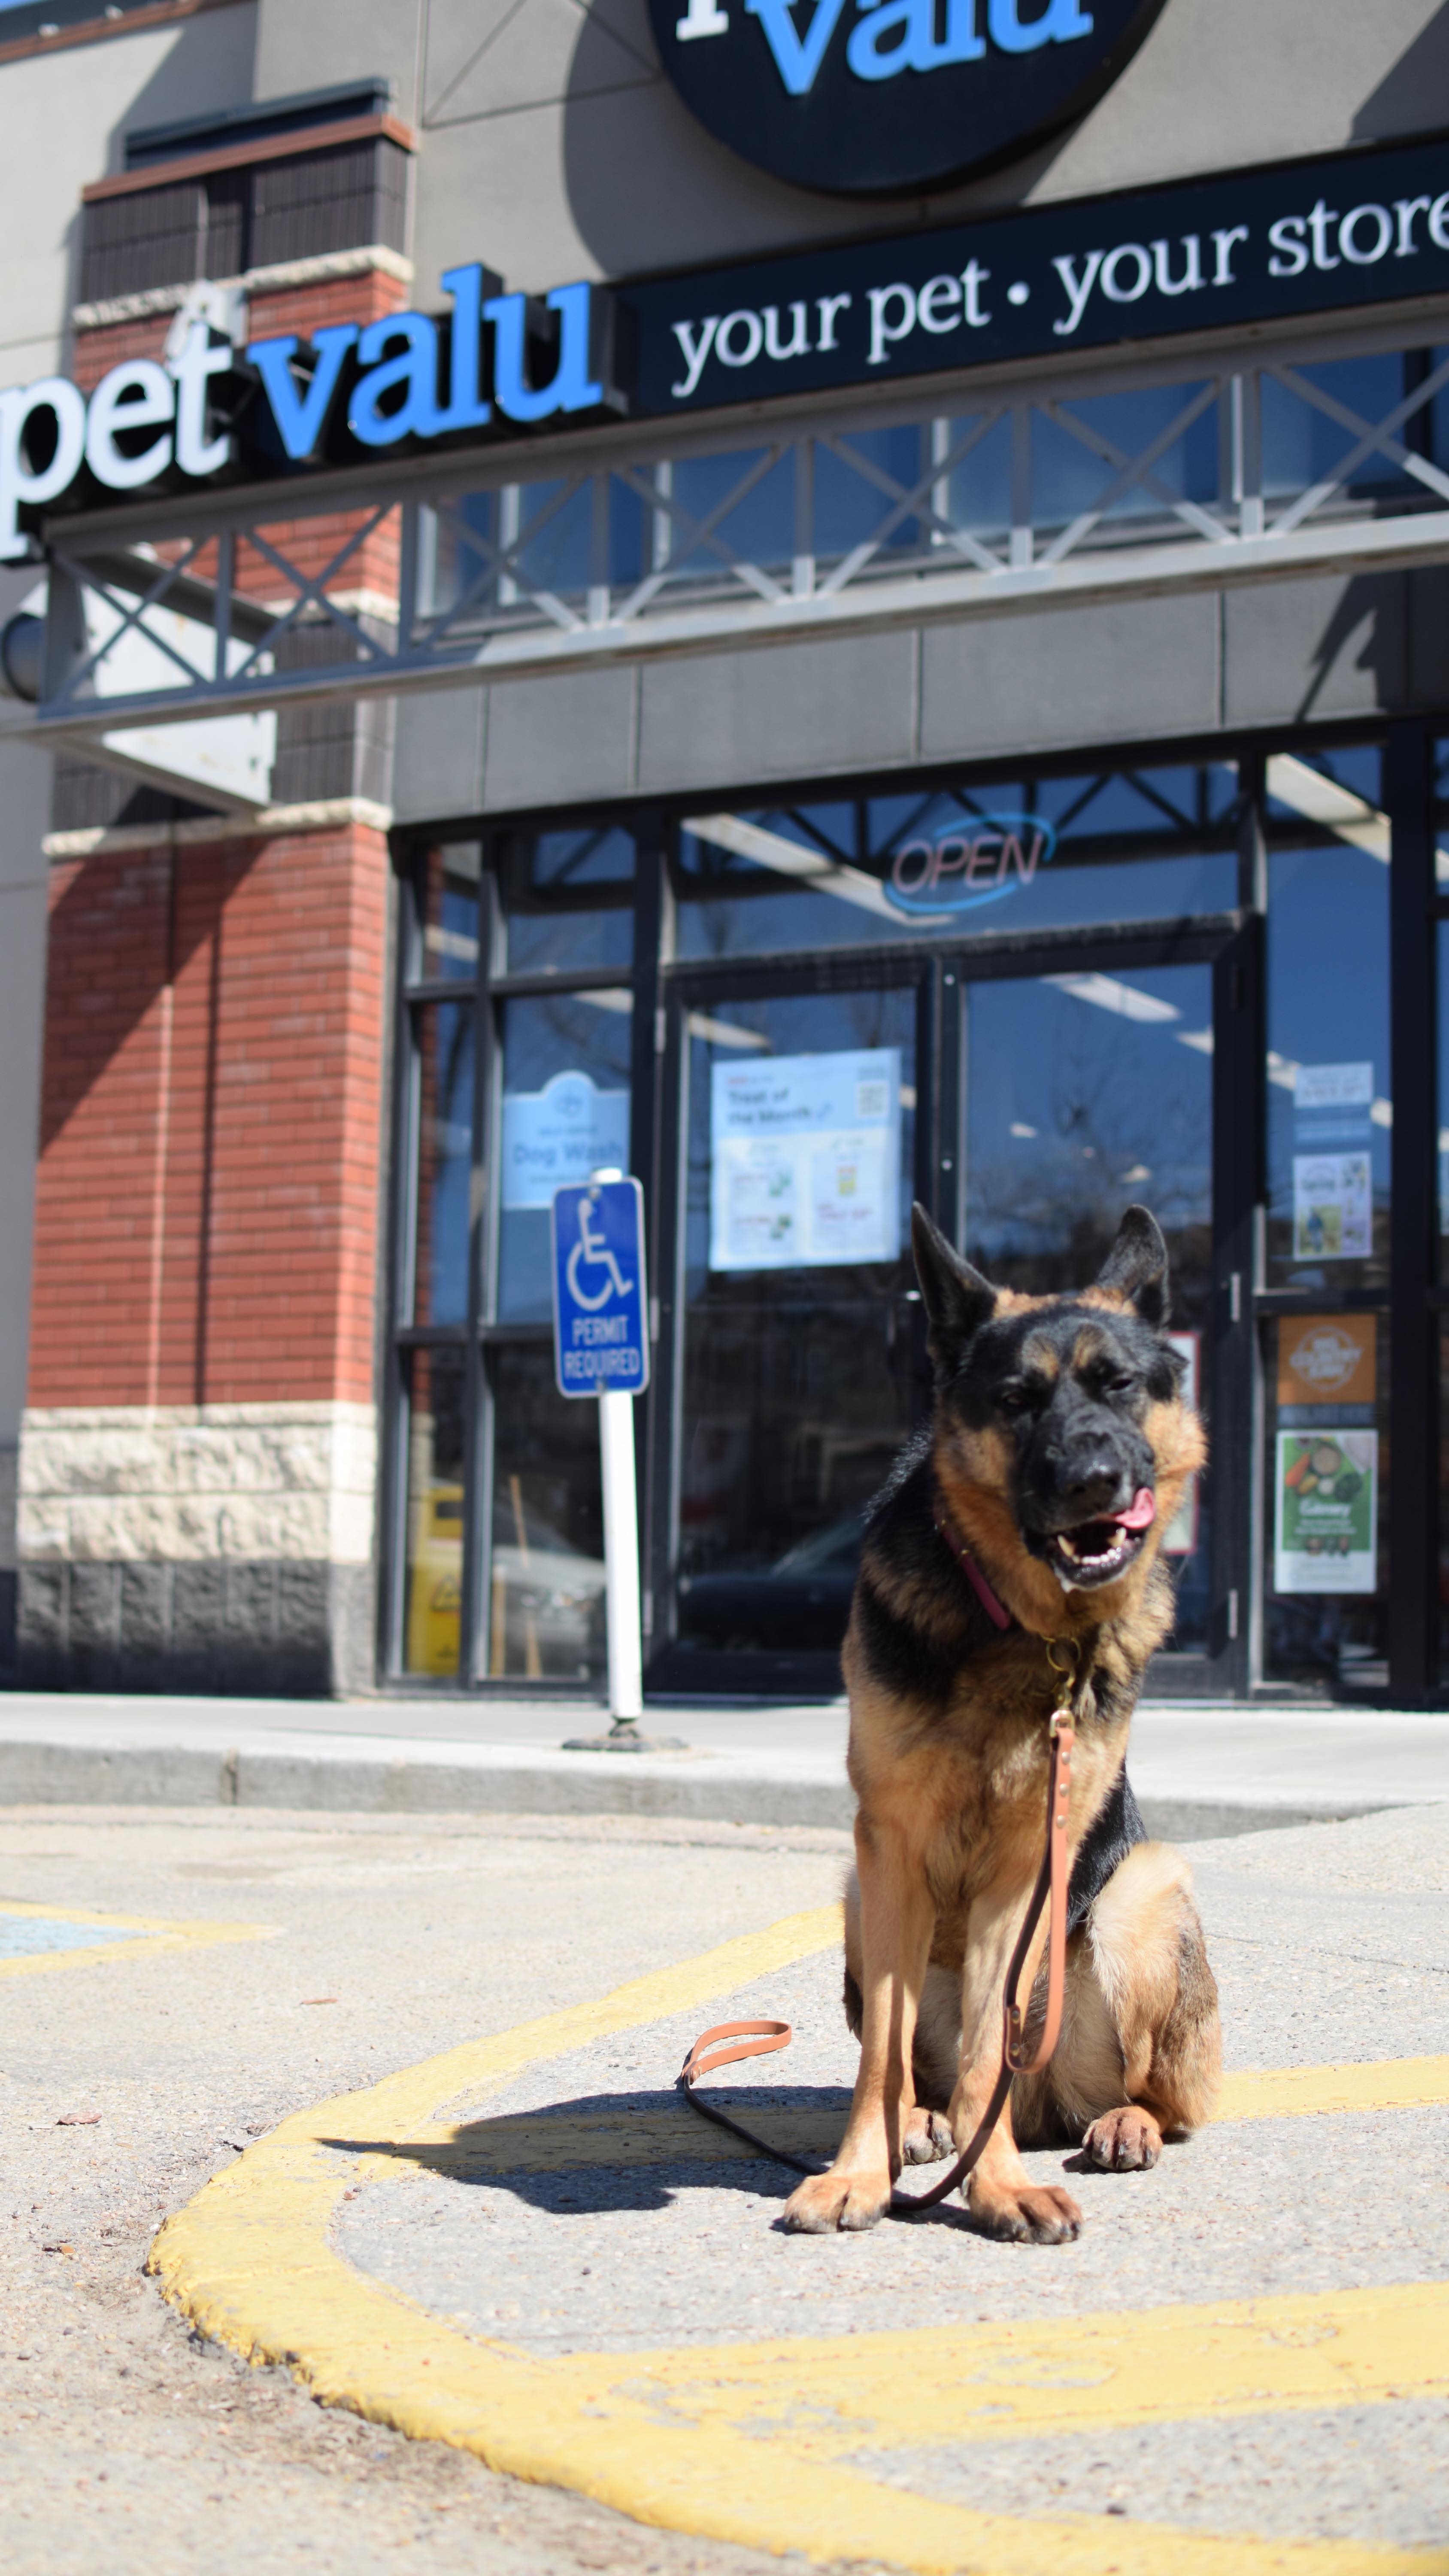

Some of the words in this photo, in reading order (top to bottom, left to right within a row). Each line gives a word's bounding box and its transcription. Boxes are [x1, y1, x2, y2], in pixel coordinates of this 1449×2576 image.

[671, 293, 852, 398] your
[866, 260, 992, 365] pet
[1052, 226, 1249, 335] your
[0, 321, 233, 559] pet
[248, 263, 603, 458] valu
[892, 832, 1043, 894] OPEN
[728, 1090, 767, 1105] Treat
[774, 1086, 791, 1104] of
[729, 1112, 753, 1126] the
[758, 1107, 810, 1124] Month
[513, 1142, 557, 1168] Dog
[562, 1140, 622, 1162] Wash
[572, 1315, 629, 1346] PERMIT
[564, 1347, 640, 1379] REQUIRED
